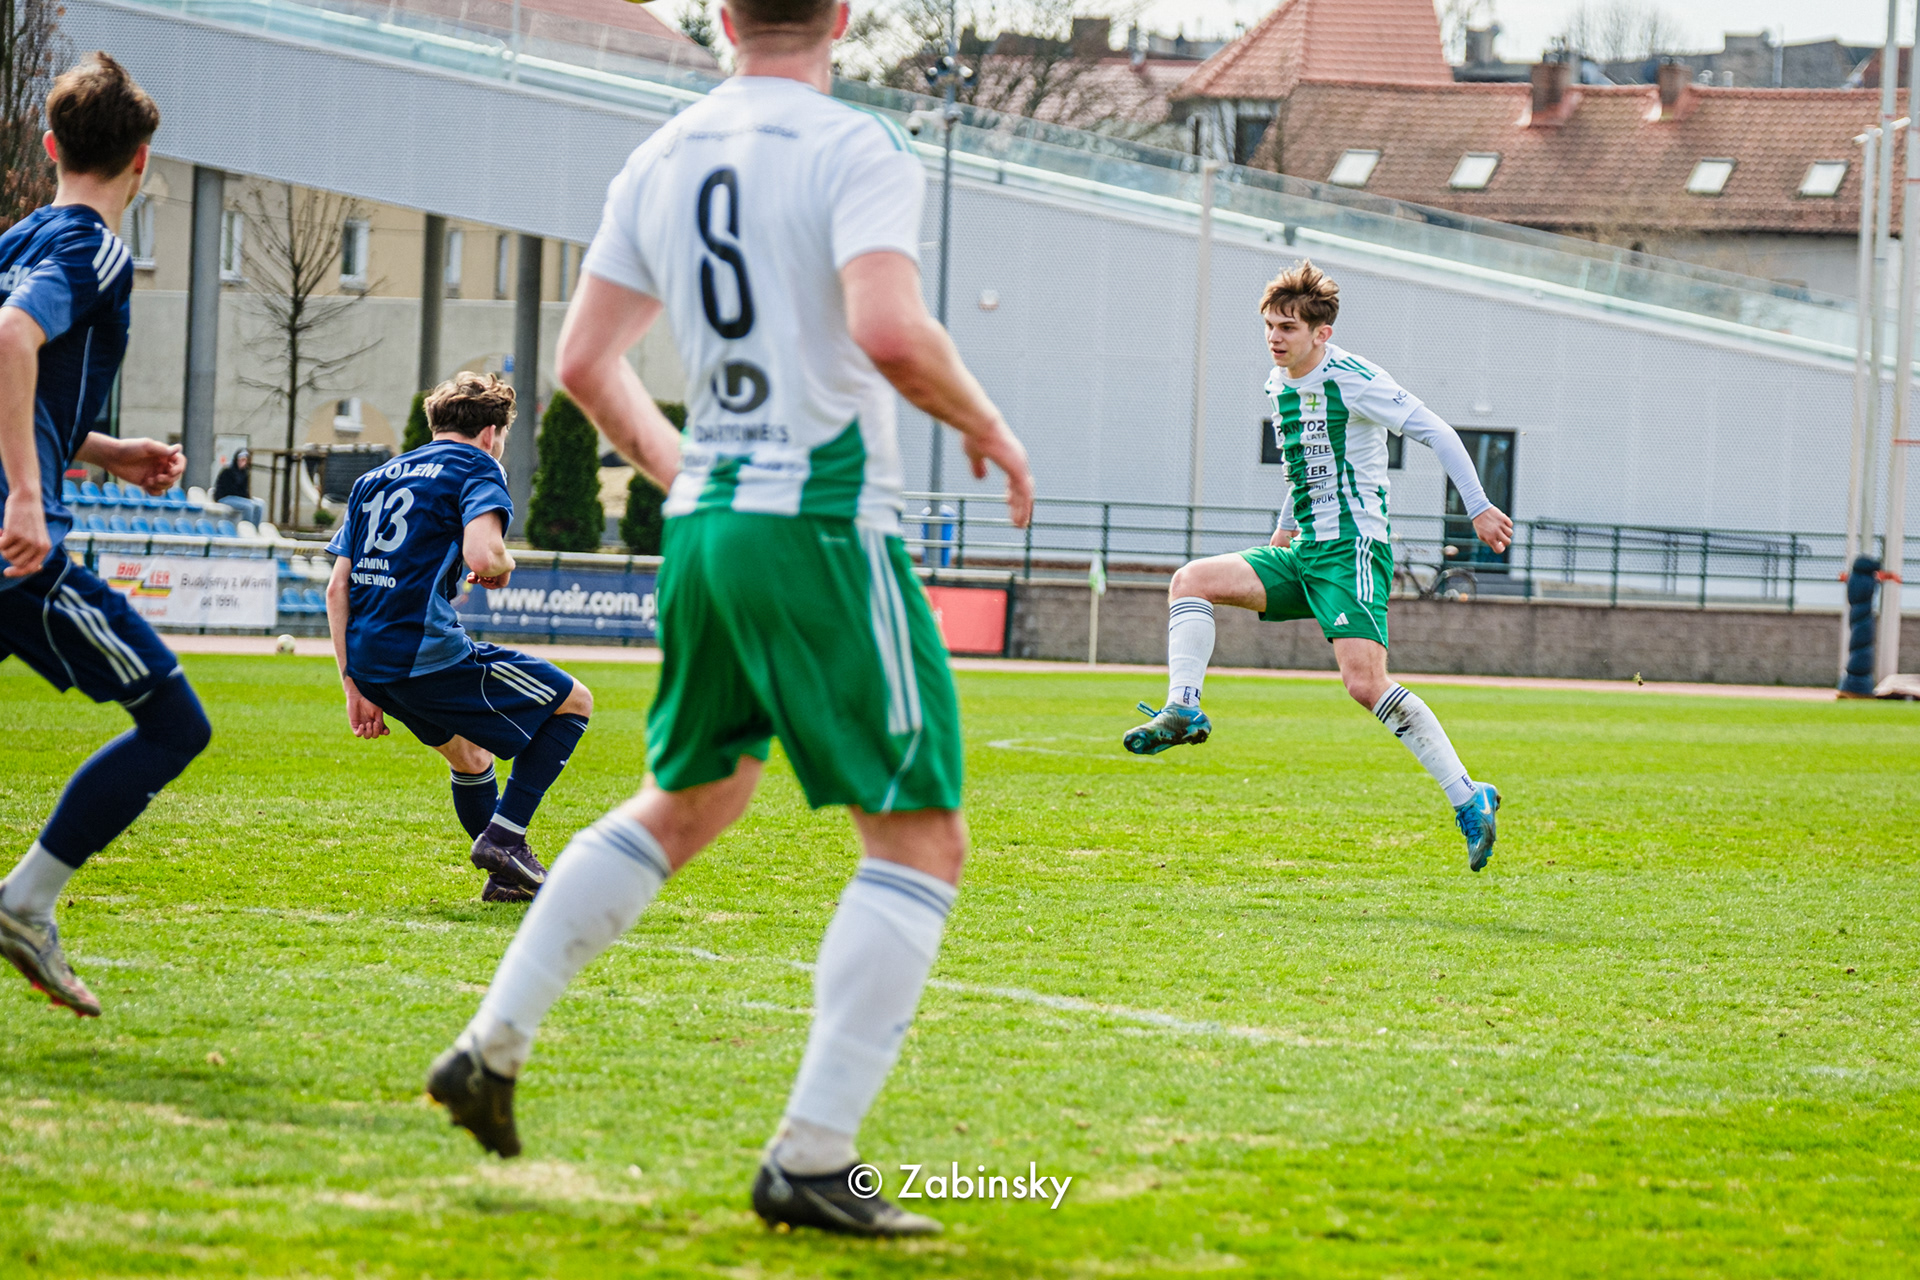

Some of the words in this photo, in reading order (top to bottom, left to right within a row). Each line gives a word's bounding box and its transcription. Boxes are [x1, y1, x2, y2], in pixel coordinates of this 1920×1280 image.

[362, 487, 415, 554] 13
[356, 557, 390, 571] GMINA
[486, 583, 656, 621] www.osir.com.p
